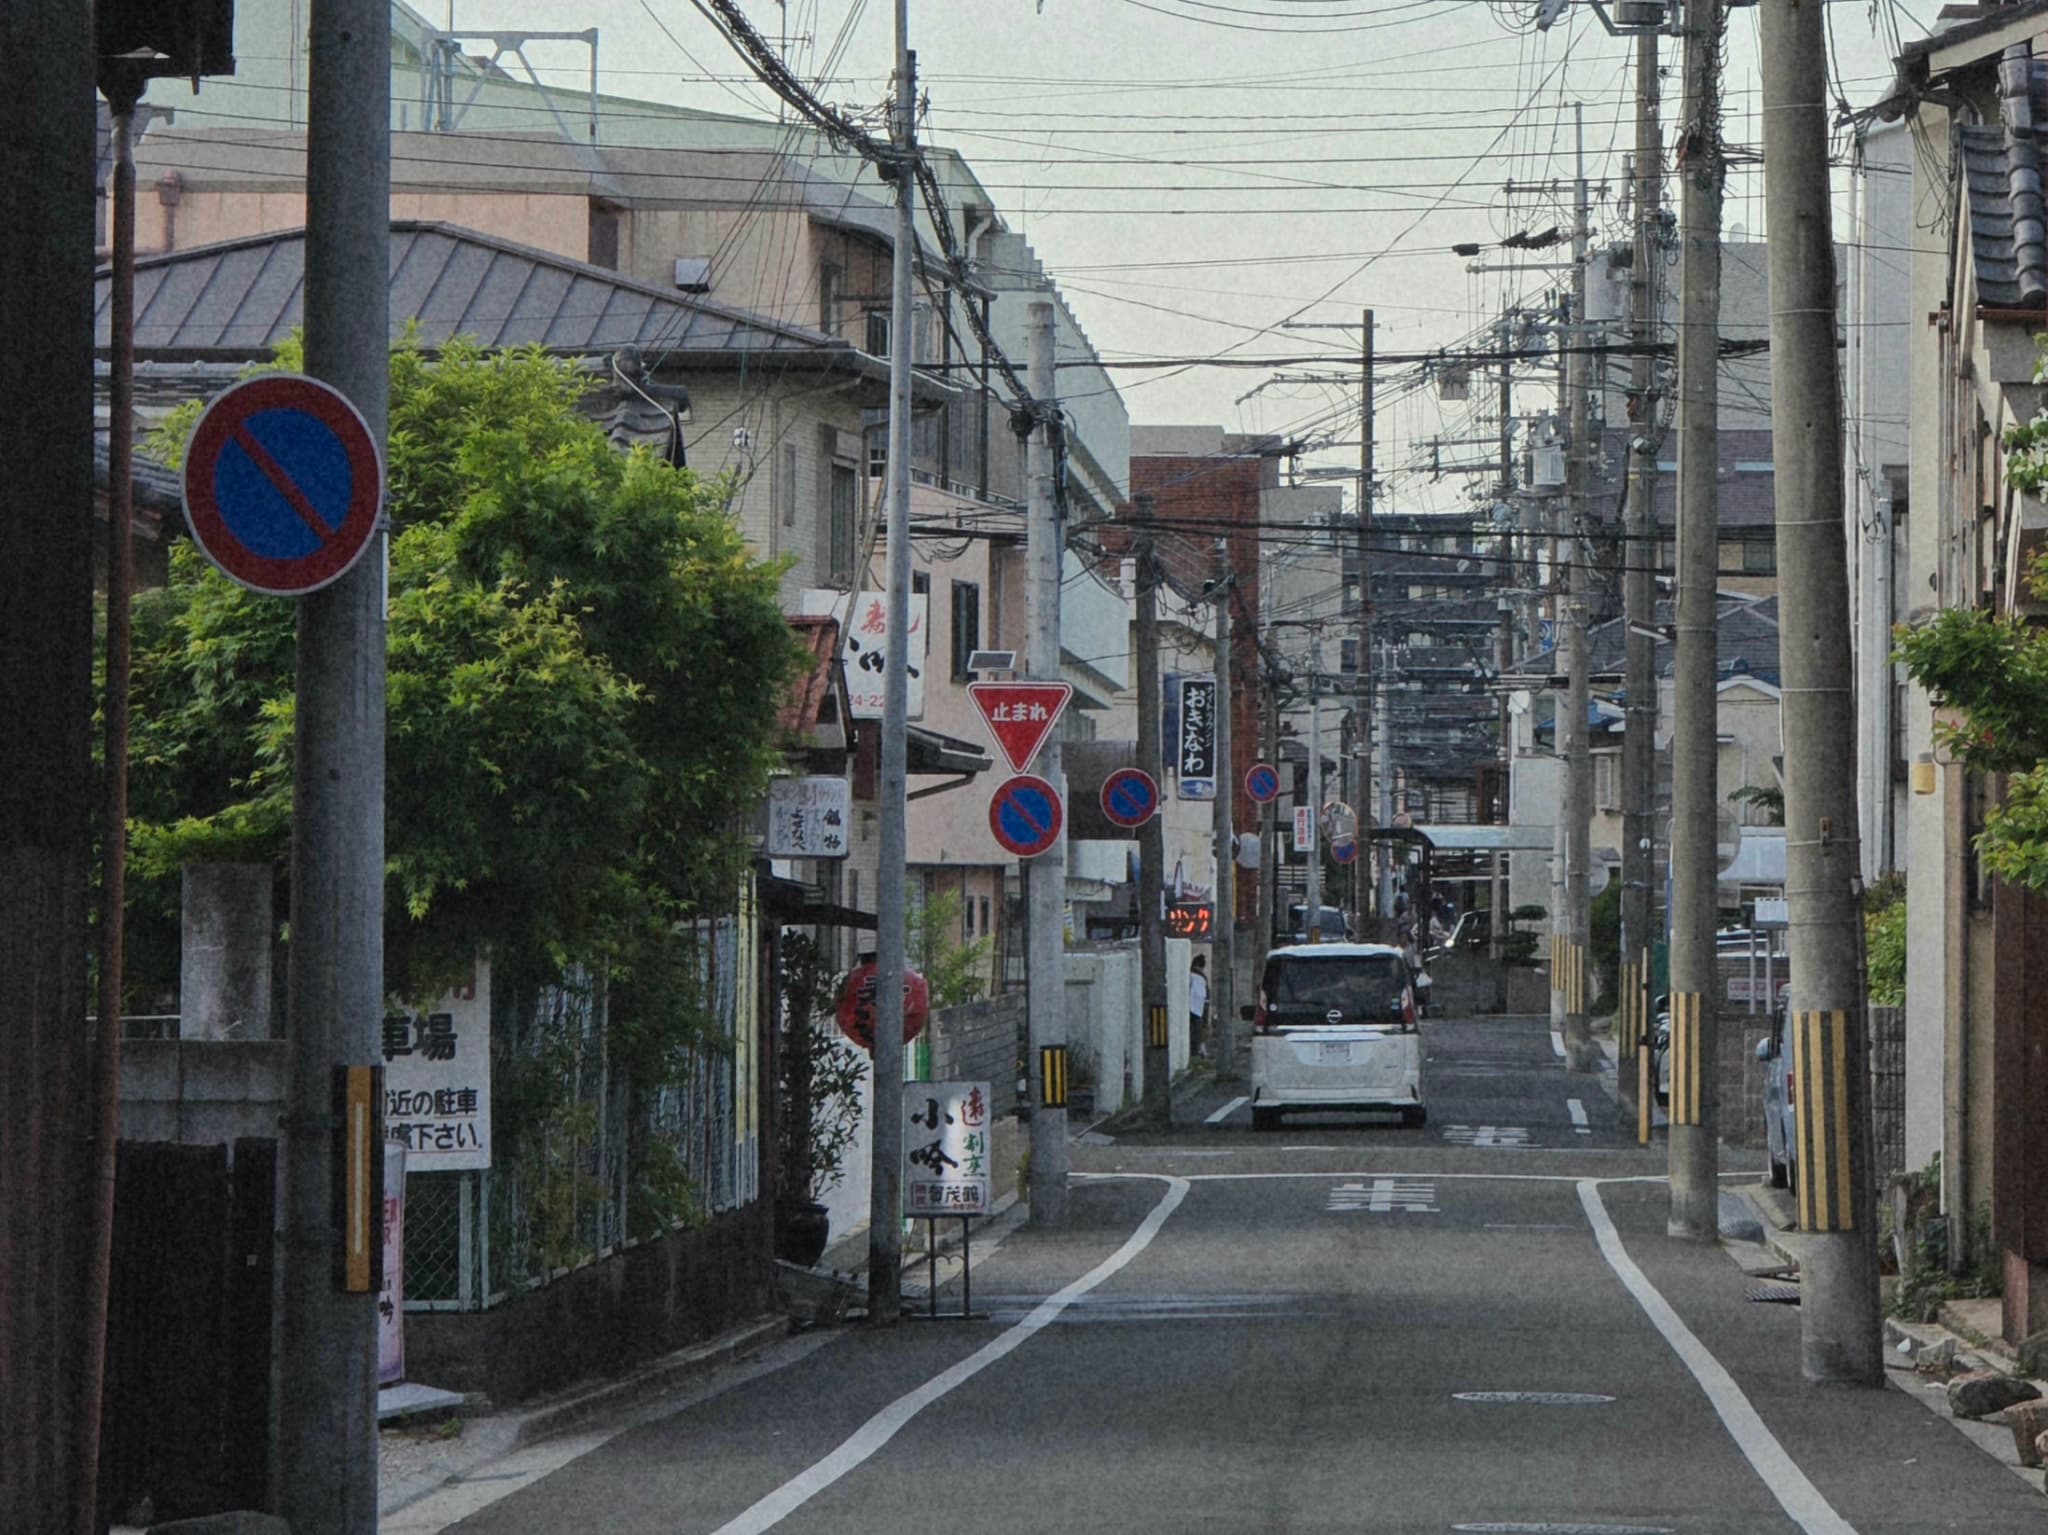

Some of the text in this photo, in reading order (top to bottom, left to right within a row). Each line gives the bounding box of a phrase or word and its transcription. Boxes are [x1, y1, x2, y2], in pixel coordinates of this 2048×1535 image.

[991, 701, 1048, 722] 止まれ
[1184, 687, 1206, 774] おきなわ
[384, 1086, 478, 1116] 近の駐車
